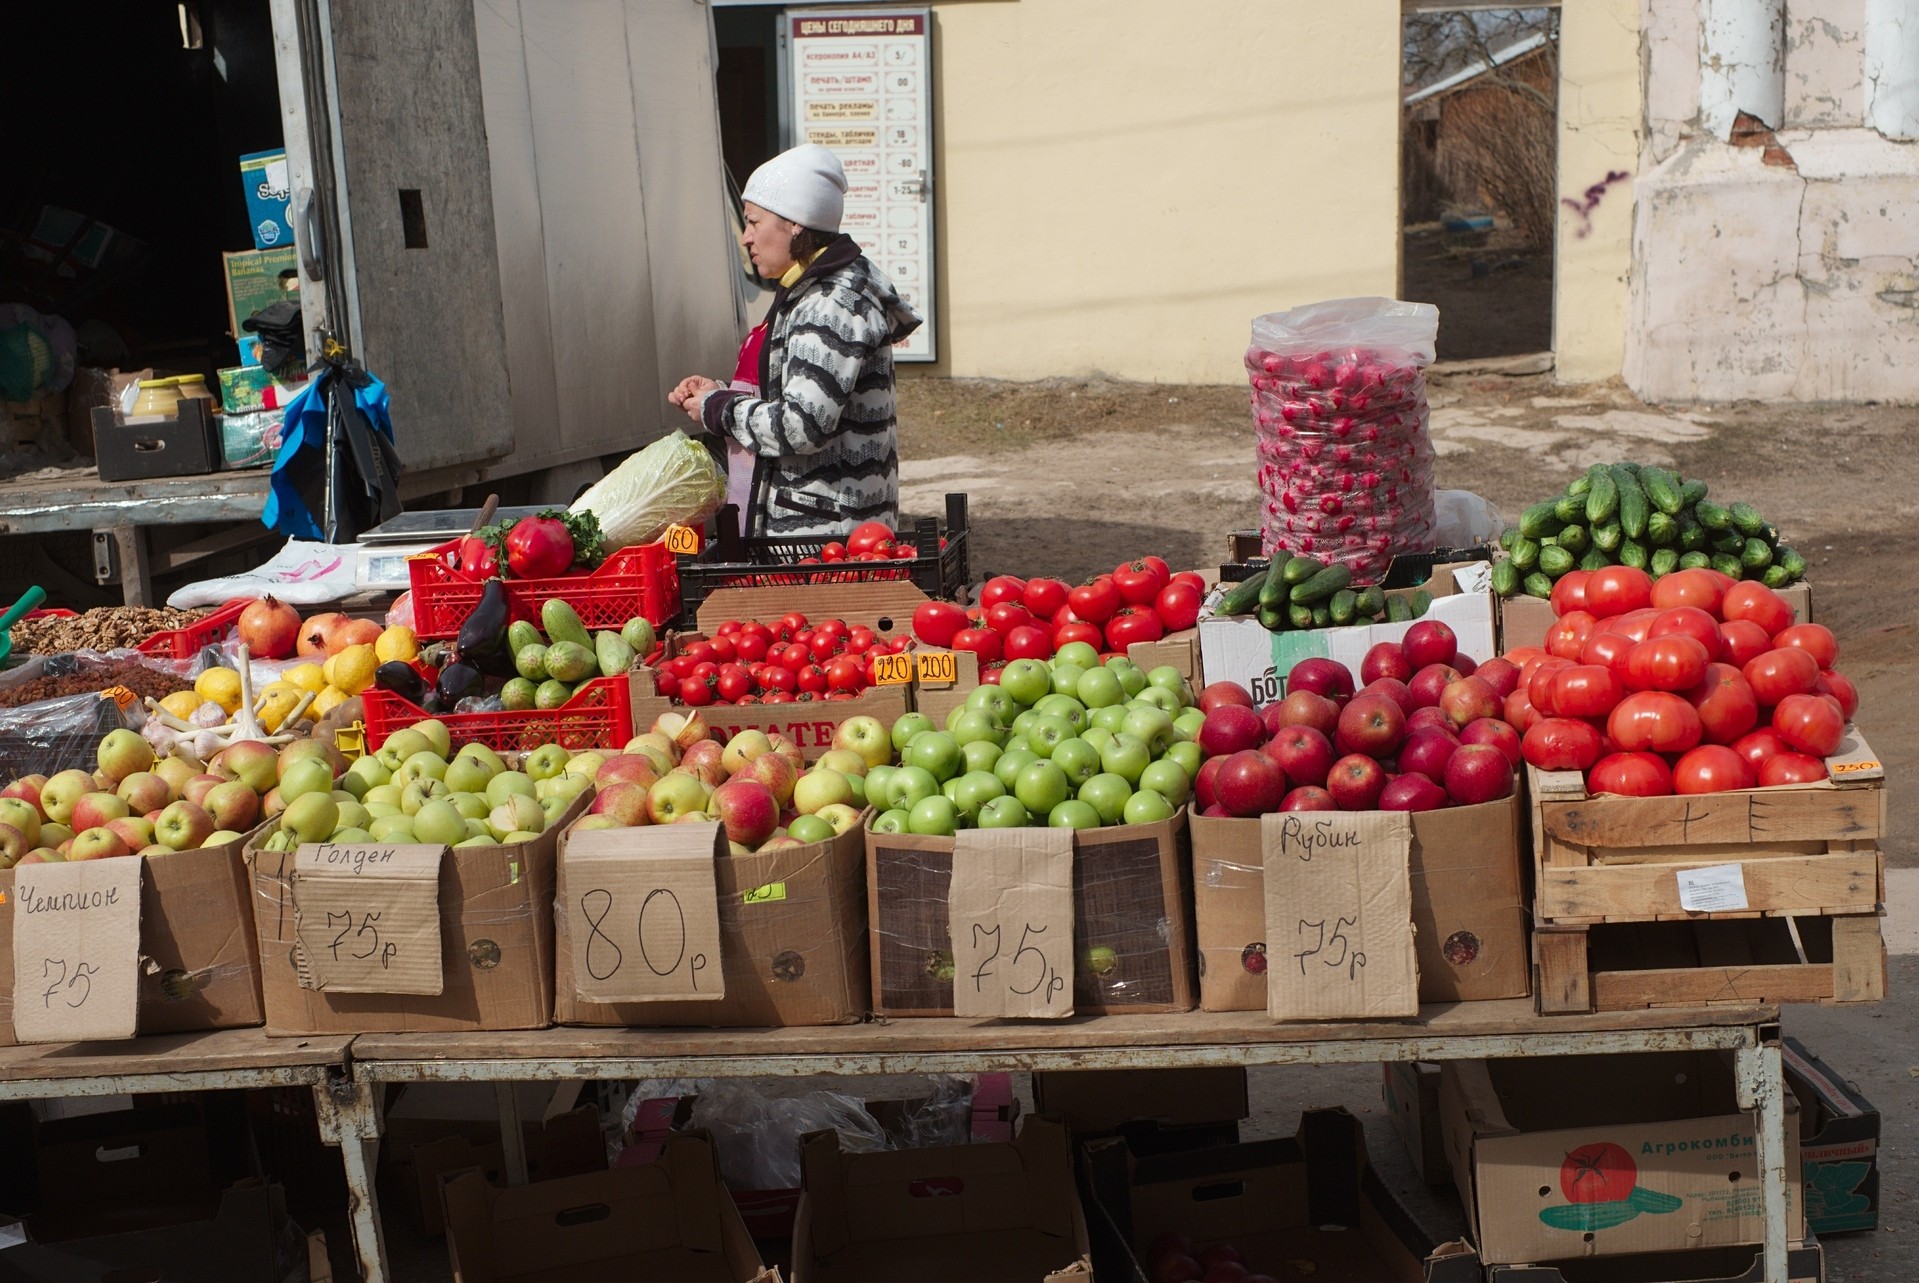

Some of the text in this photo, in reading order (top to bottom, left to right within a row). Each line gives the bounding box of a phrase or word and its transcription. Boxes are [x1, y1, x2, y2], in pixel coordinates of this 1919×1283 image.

[801, 19, 915, 35] ЦЕНЫ СЕГОДНЯШНЕГО ДНЯ
[667, 528, 693, 550] 160
[877, 655, 908, 681] 220
[921, 654, 952, 679] 200
[1280, 815, 1362, 862] Рубин
[314, 843, 396, 875] Голден
[20, 885, 120, 914] Чемпион
[42, 958, 101, 1009] 75
